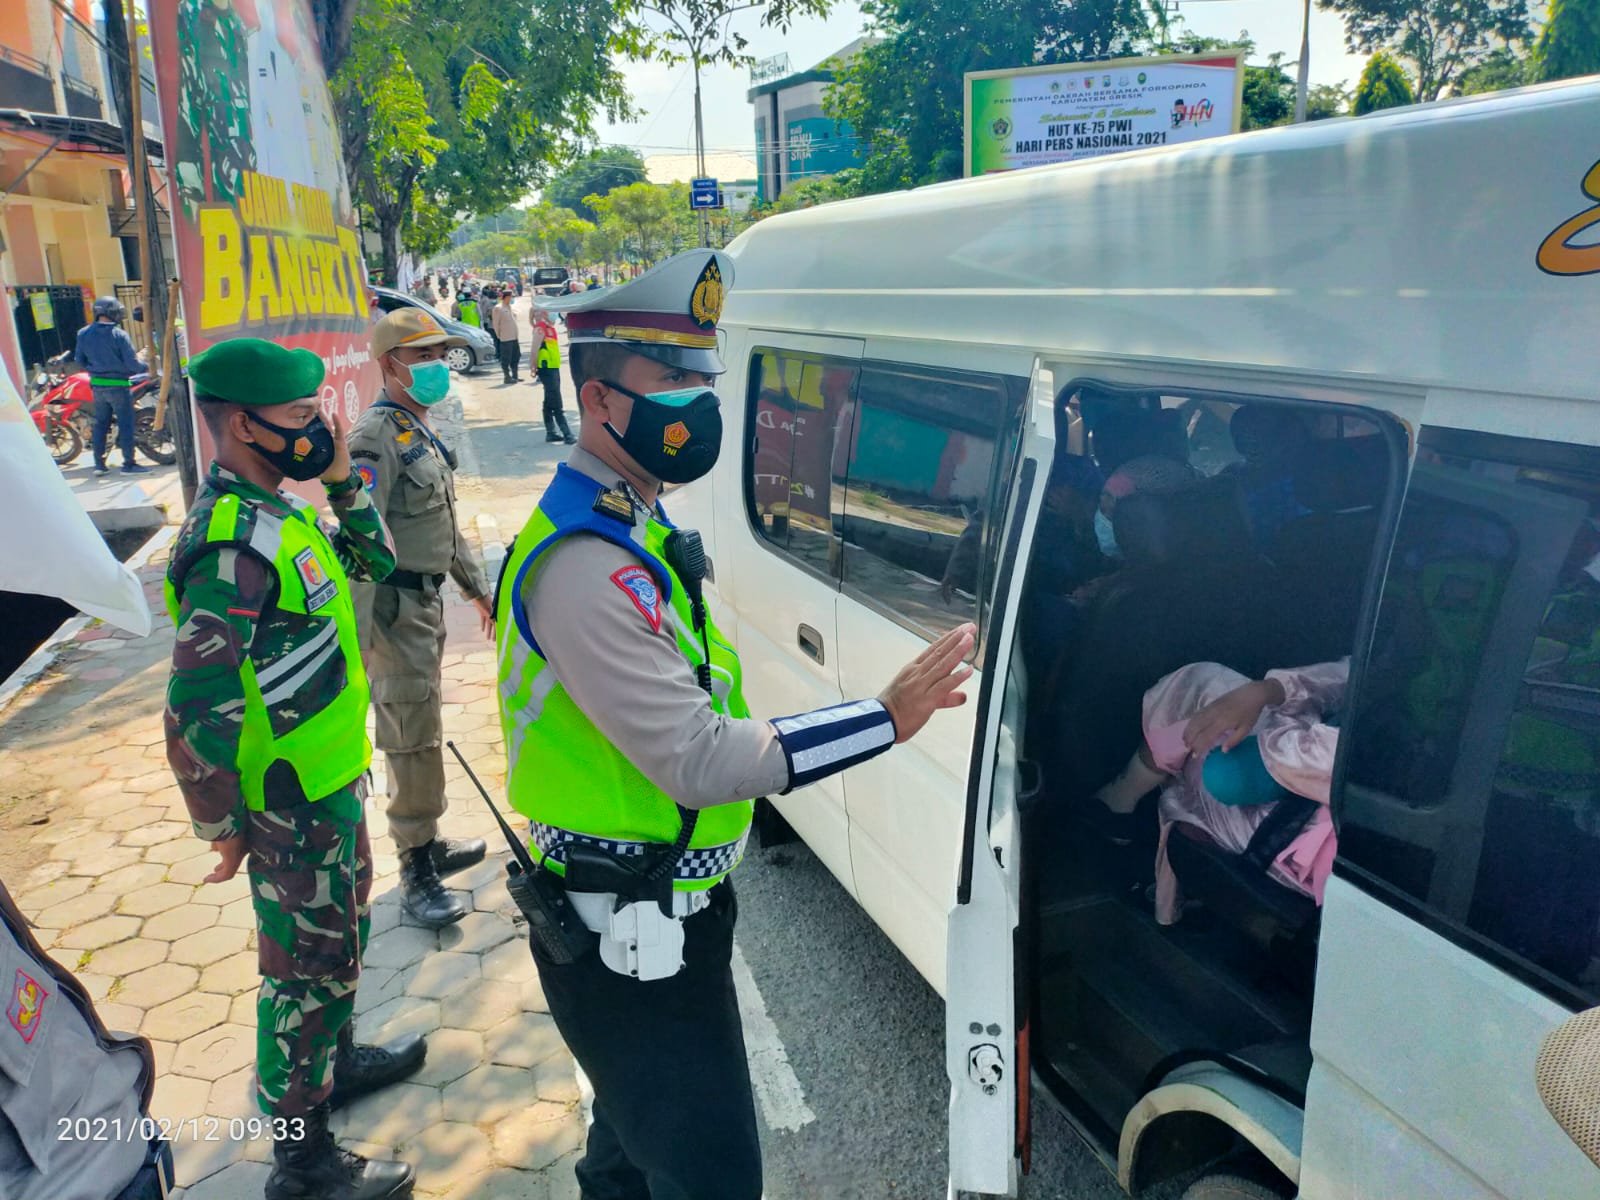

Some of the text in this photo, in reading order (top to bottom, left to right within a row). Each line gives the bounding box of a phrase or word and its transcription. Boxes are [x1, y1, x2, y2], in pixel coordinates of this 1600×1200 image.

[994, 95, 1051, 104] PEMERINTAH
[1053, 92, 1091, 100] DAERAH
[1093, 88, 1139, 96] BERSAMA
[1051, 93, 1143, 105] KABUPATEN GRESIK
[1048, 119, 1132, 137] HUT KE-75 PWI
[1015, 139, 1042, 153] HARI
[1045, 138, 1073, 151] PERS
[1076, 133, 1133, 150] NASIONAL
[1136, 131, 1166, 145] 2021
[239, 170, 336, 238] JAWA TIMUR
[200, 208, 369, 329] BANGKIT
[663, 445, 678, 457] TNI
